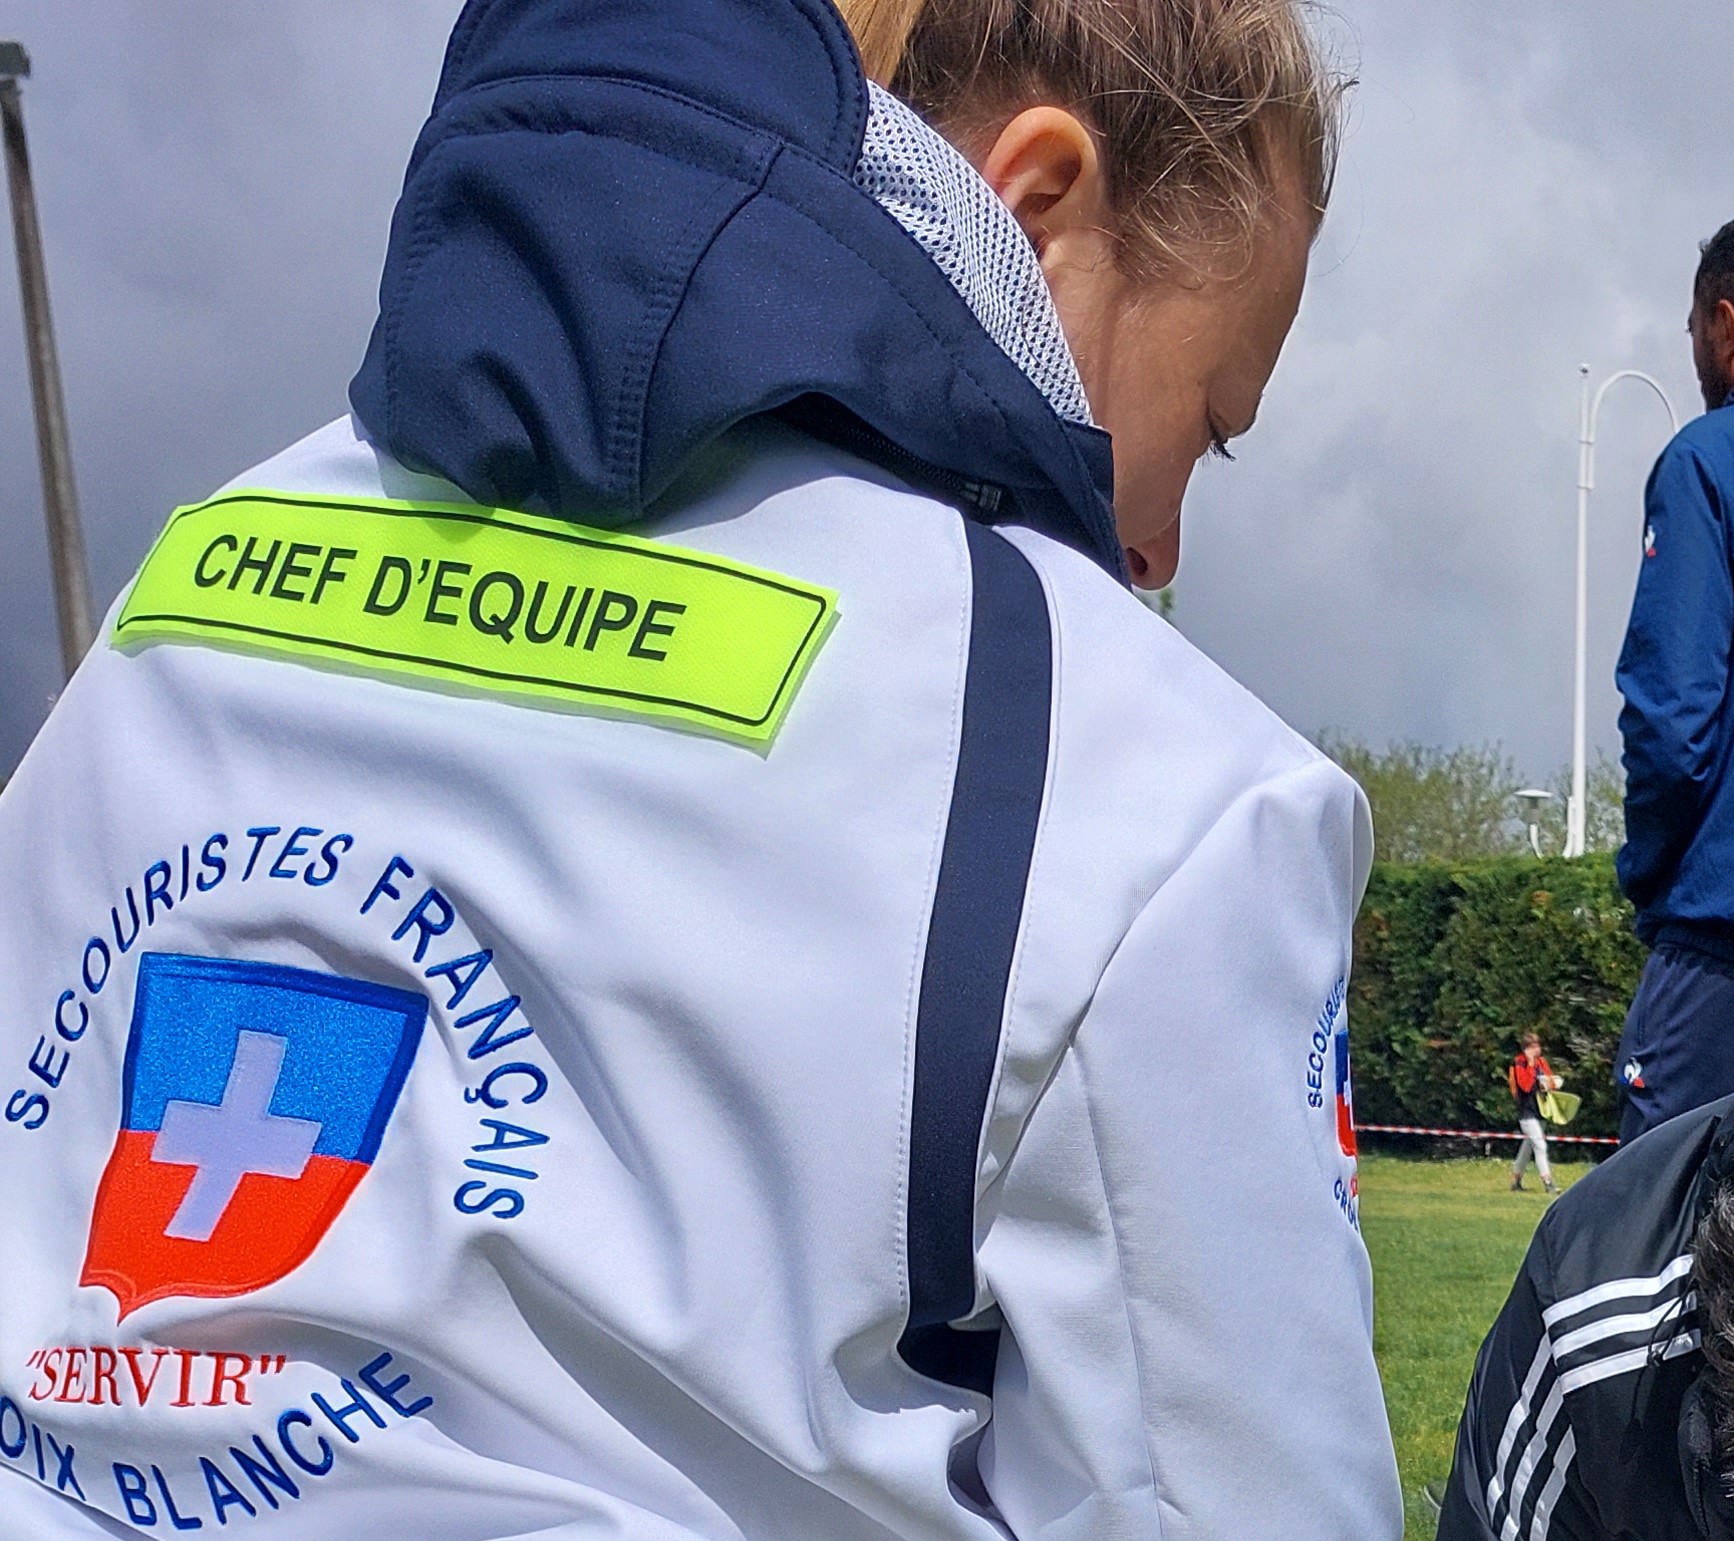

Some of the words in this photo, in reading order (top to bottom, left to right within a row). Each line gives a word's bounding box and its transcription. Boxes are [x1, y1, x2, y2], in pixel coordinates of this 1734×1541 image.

[194, 533, 356, 606] CHEF
[363, 556, 687, 662] D'EQUIPE
[5, 826, 354, 1131] SECOURISTES
[360, 855, 549, 1219] FRANÇAIS
[26, 1345, 287, 1408] "SERVIR"
[113, 1351, 434, 1531] BLANCHE
